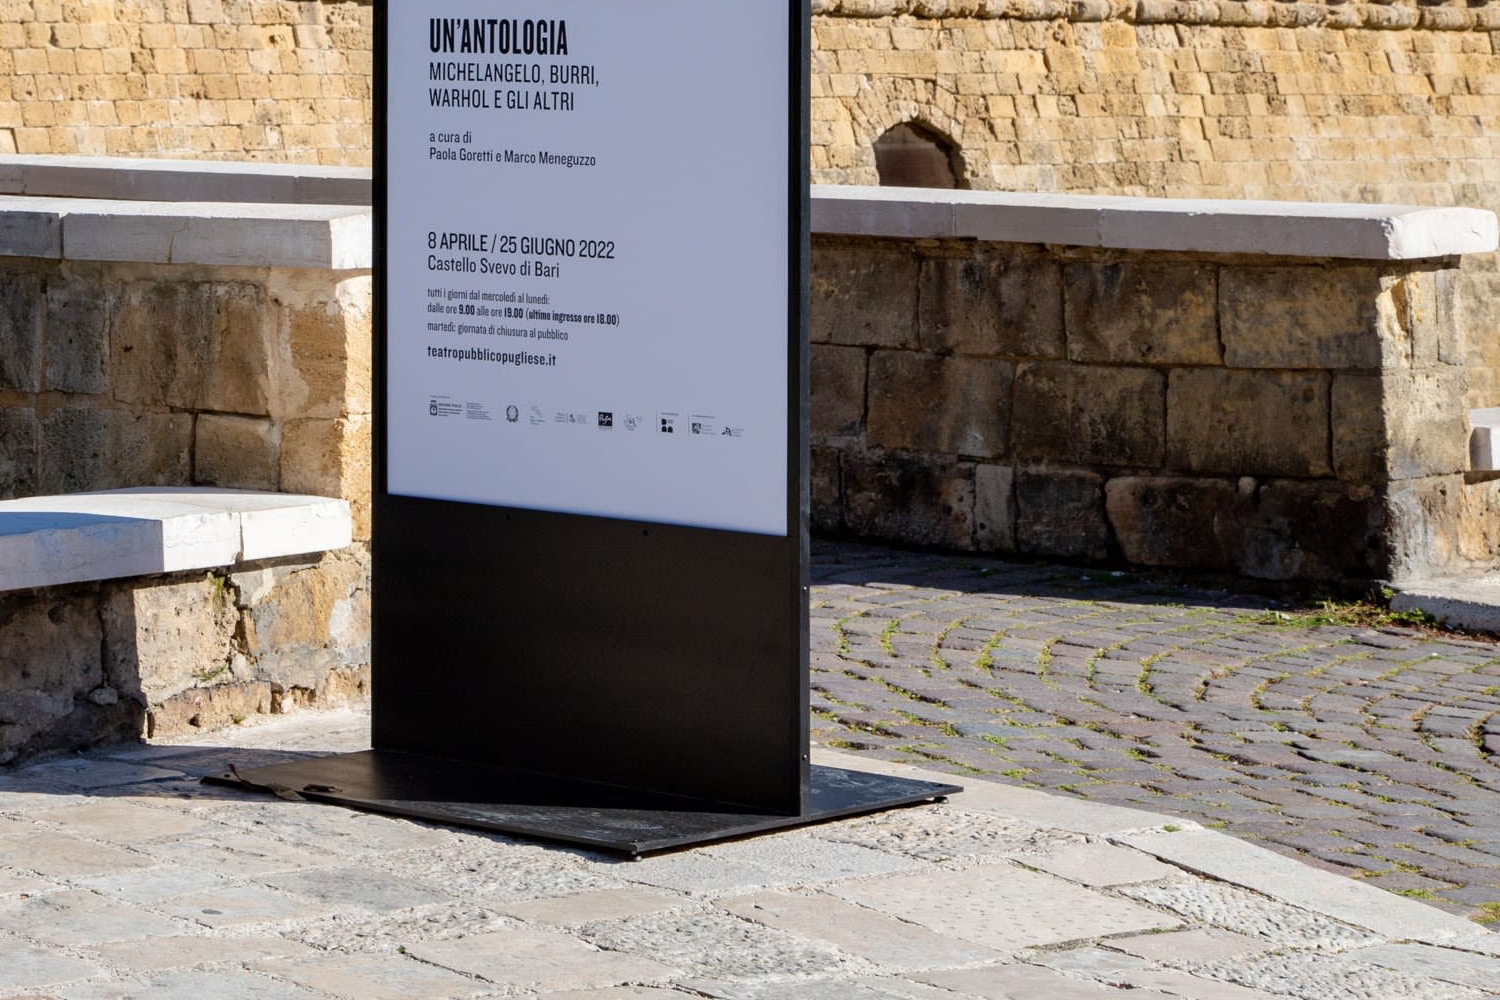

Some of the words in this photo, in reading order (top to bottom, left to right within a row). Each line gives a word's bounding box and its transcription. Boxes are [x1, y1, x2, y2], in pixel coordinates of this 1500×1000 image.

[429, 18, 568, 55] UN'ANTOLOGIA
[430, 62, 545, 85] MICHELANGELO,
[550, 65, 598, 87] BURRI,
[429, 88, 489, 108] WARHOL
[494, 90, 501, 108] E
[507, 91, 528, 109] GLI
[534, 92, 573, 111] ALTRI
[430, 133, 435, 142] a
[438, 133, 460, 143] cura
[463, 131, 472, 144] di
[430, 148, 456, 160] Paola
[459, 148, 492, 162] Goretti
[496, 153, 501, 162] e
[504, 150, 535, 163] Marco
[539, 152, 596, 167] Meneguzzo
[428, 232, 436, 249] 8
[440, 233, 487, 252] APRILE
[491, 234, 496, 253] /
[500, 236, 516, 254] 25
[521, 236, 575, 257] GIUGNO
[579, 240, 615, 259] 2022
[428, 255, 476, 273] Castello
[480, 258, 516, 275] Svevo
[520, 261, 530, 276] di
[535, 261, 559, 278] Bari
[428, 289, 442, 298] tutti
[448, 290, 467, 301] giorni
[469, 290, 480, 301] dal
[518, 293, 524, 303] al
[428, 303, 444, 313] dalle
[446, 306, 457, 314] ore
[459, 305, 474, 315] 9.00
[477, 305, 489, 316] alle
[491, 309, 502, 317] ore
[504, 307, 523, 318] 19.00
[552, 310, 582, 325] ingresso
[584, 315, 595, 323] ore
[597, 314, 620, 327] 18.00)
[458, 323, 487, 335] giornata
[489, 325, 495, 335] di
[497, 325, 528, 337] chiusura
[530, 327, 536, 337] al
[538, 328, 568, 340] pubblico
[428, 346, 556, 366] teatropubblicopugliese.it
